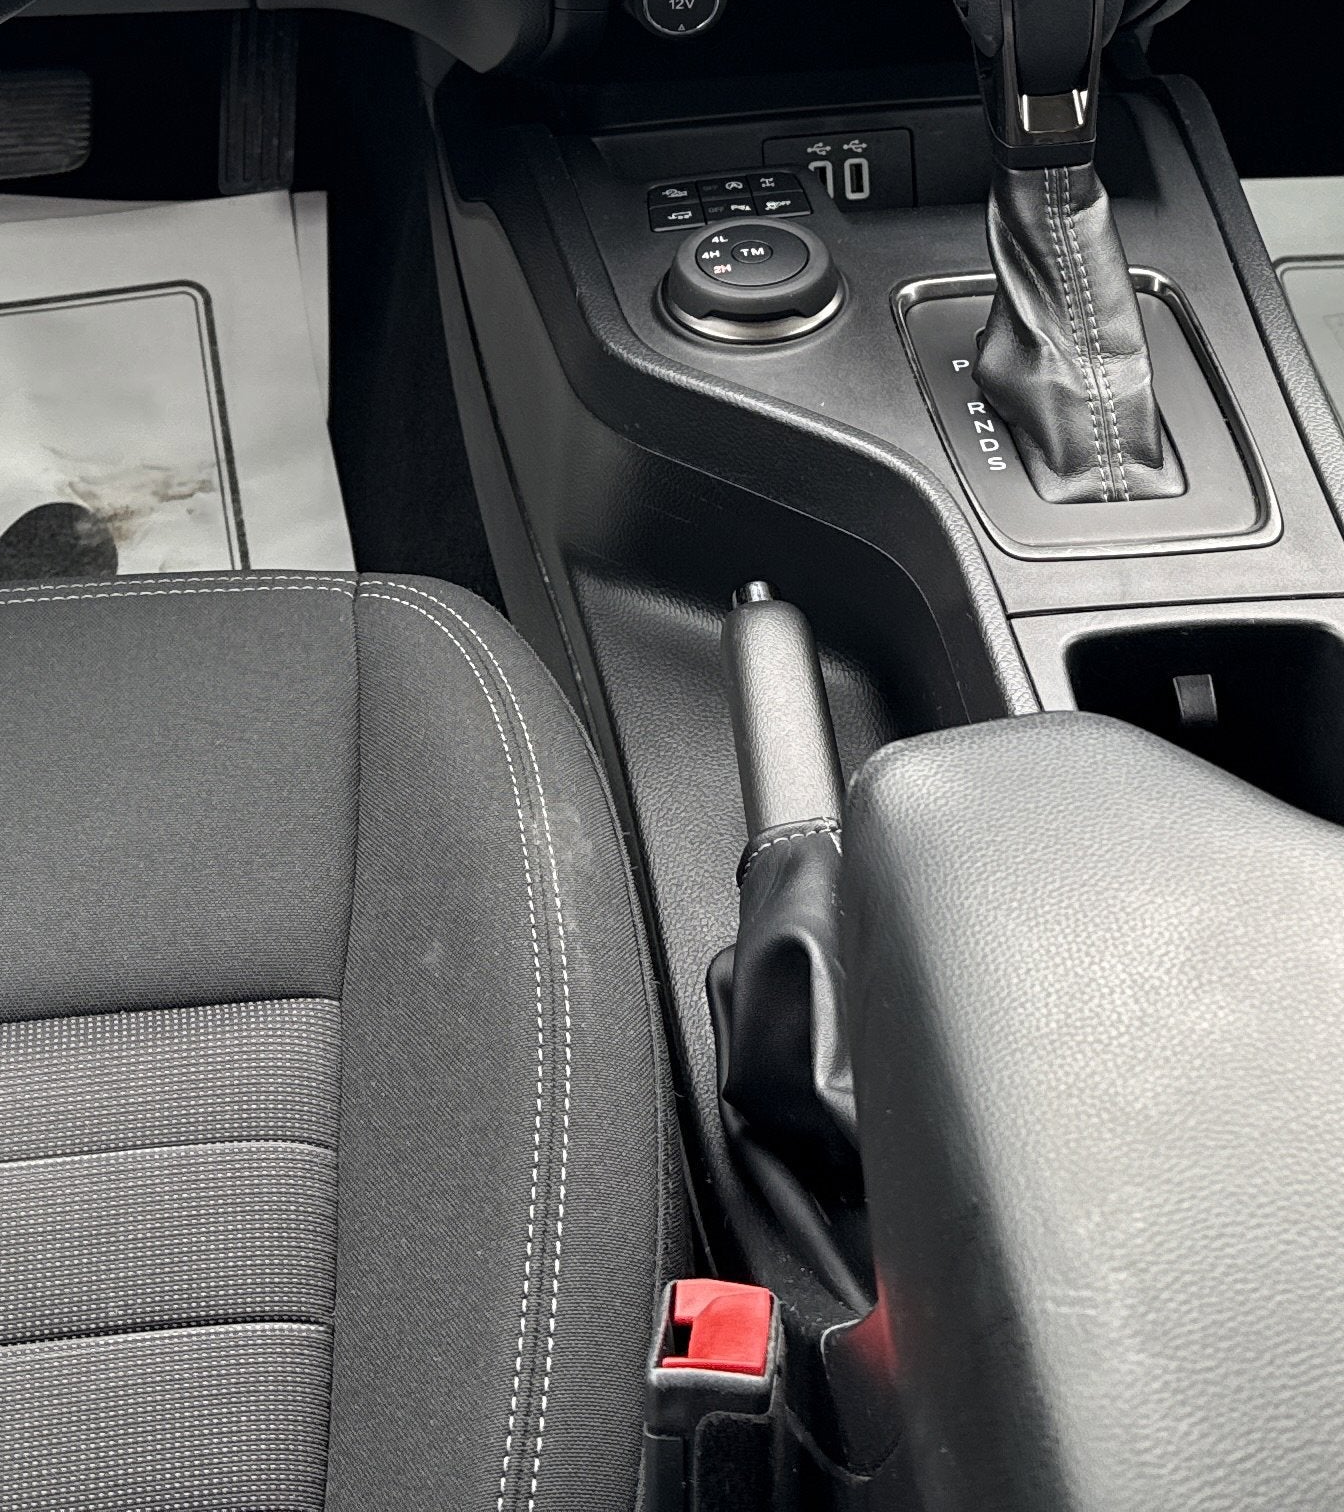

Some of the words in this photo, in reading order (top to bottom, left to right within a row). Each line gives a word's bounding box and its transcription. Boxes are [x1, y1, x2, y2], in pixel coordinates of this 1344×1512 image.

[712, 235, 728, 243] 4L
[702, 250, 720, 259] 4H
[740, 247, 765, 257] TM
[714, 264, 731, 274] 2H
[952, 360, 969, 371] P
[967, 402, 985, 415] R
[974, 420, 994, 433] N
[981, 439, 999, 452] D
[989, 457, 1006, 471] S
